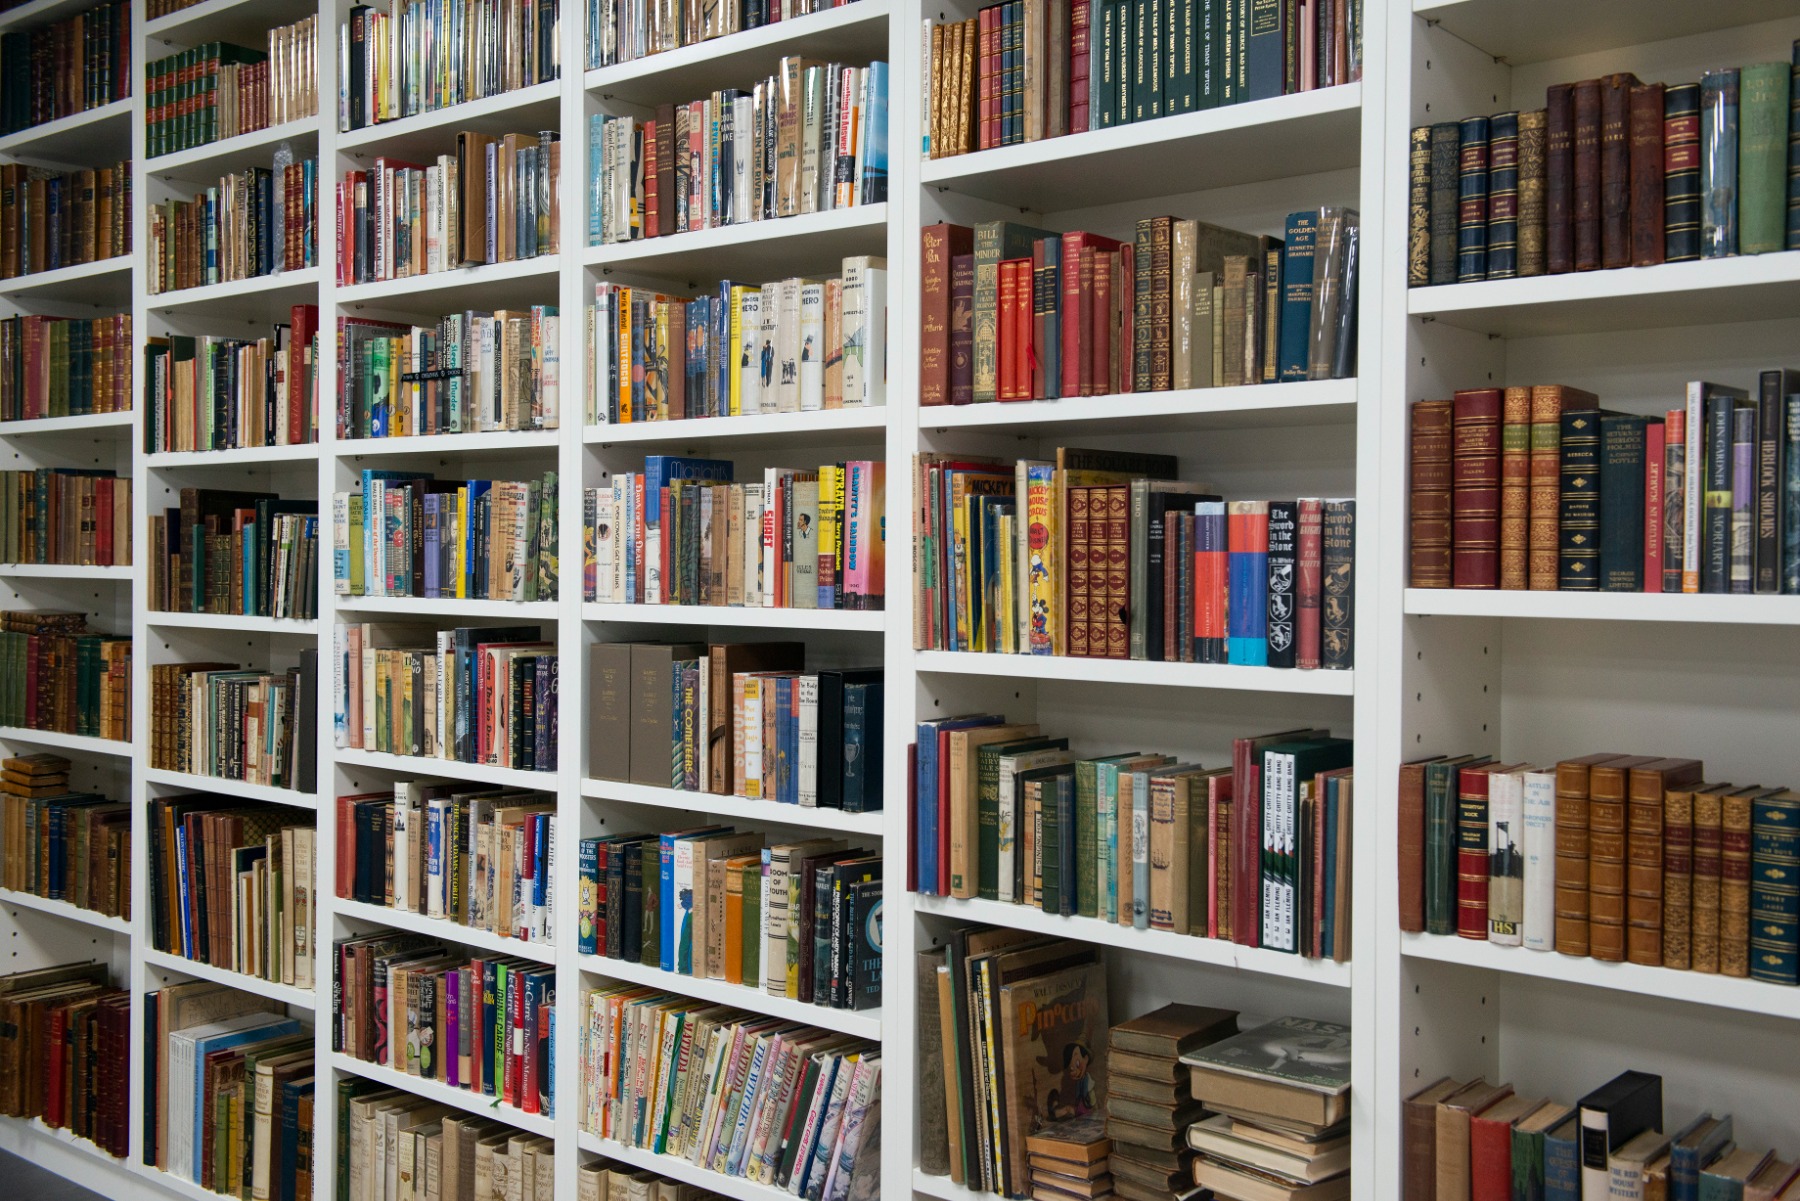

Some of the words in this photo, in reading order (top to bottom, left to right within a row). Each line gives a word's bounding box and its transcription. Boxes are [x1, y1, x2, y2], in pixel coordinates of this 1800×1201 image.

[978, 230, 998, 238] BILL
[1715, 411, 1725, 437] JOHN
[1715, 440, 1725, 486] GARDNER
[1761, 441, 1776, 487] HERLOCK
[836, 468, 844, 510] STRATA
[764, 510, 774, 548] SHAFT
[1272, 510, 1288, 519] The
[1650, 507, 1657, 516] IN
[1761, 492, 1776, 538] SHOLMES
[849, 521, 857, 570] RAINBOW
[1279, 531, 1292, 540] the
[1712, 515, 1723, 575] MORIARTY
[678, 1022, 694, 1072] MATILDA
[733, 1042, 752, 1093] MATILDA
[753, 1045, 765, 1067] THE
[523, 1066, 531, 1098] Manager
[779, 1052, 798, 1103] MATILDA
[738, 1072, 758, 1128] WITCHES
